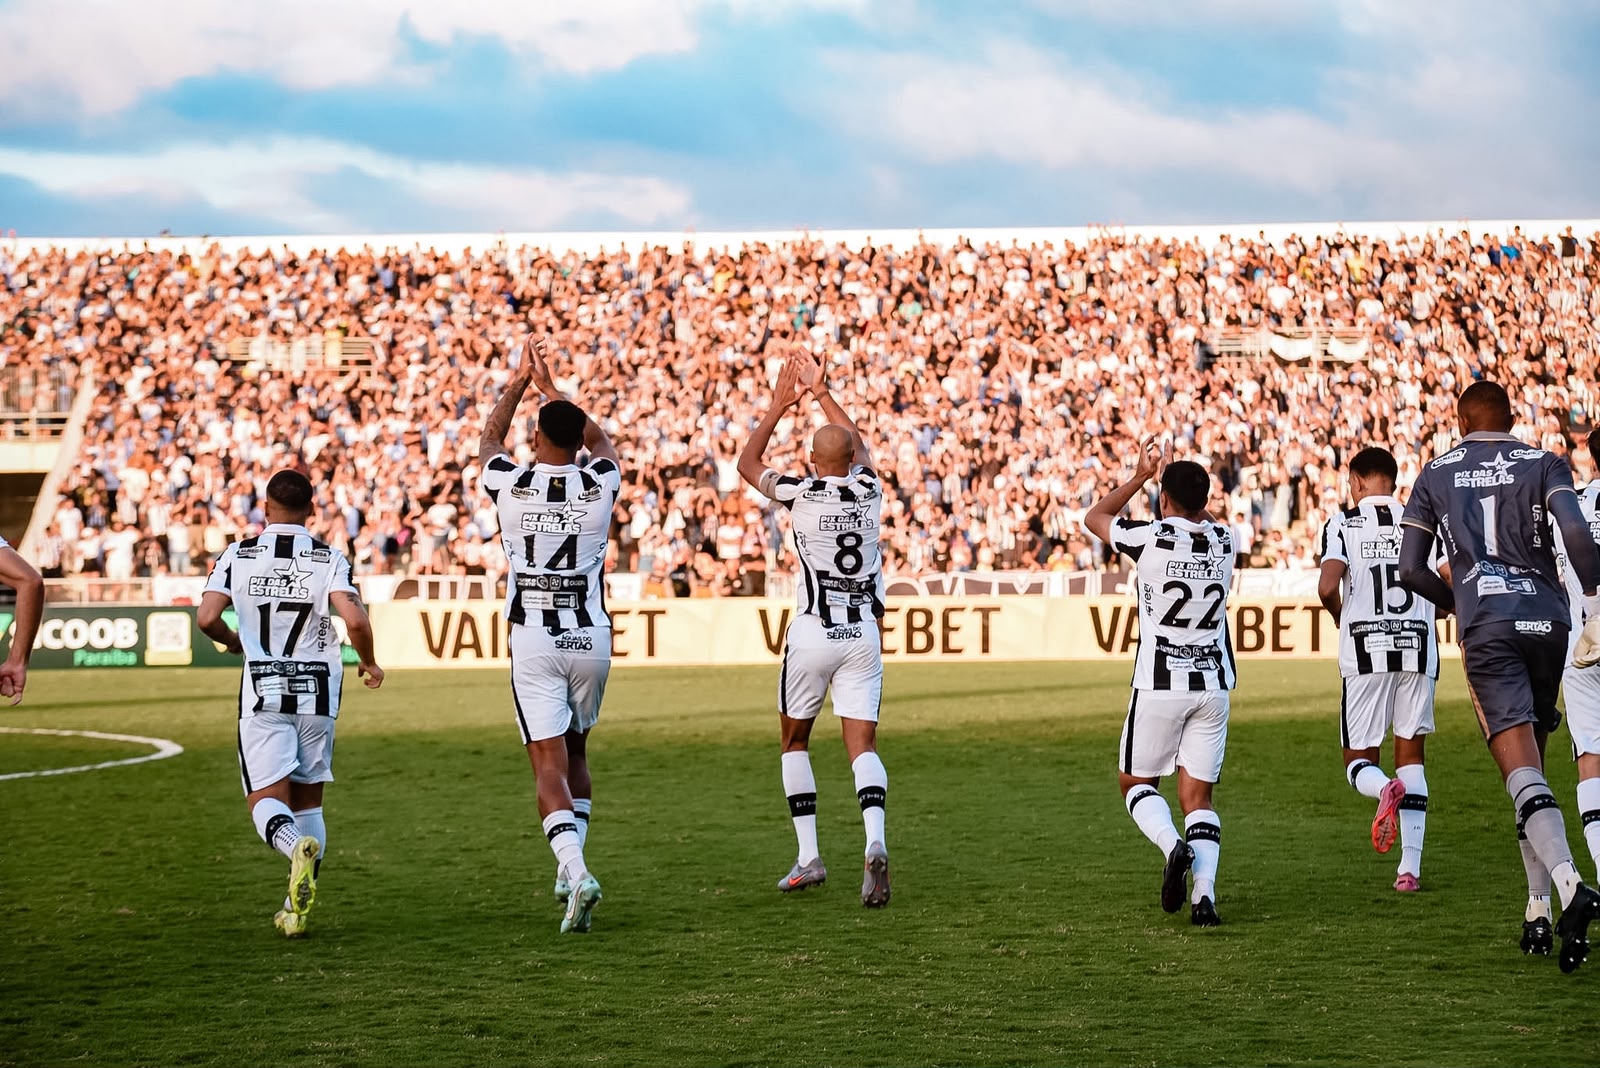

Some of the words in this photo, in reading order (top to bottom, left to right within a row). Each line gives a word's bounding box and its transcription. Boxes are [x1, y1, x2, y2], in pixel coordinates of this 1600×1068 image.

[1454, 471, 1471, 479] PIX
[1472, 469, 1493, 477] DAS
[1454, 474, 1515, 488] ESTRELAS
[523, 513, 540, 522] PIX
[540, 514, 560, 523] DAS
[821, 515, 837, 523] PIX
[837, 515, 855, 523] DAS
[522, 521, 581, 534] ESTRELAS
[820, 520, 874, 531] ESTRELAS
[1479, 494, 1499, 557] 1
[1362, 542, 1375, 550] PIX
[1376, 542, 1392, 550] DAS
[523, 534, 578, 571] 14
[834, 532, 863, 576] 8
[1362, 548, 1400, 559] ESTREL
[1169, 561, 1184, 569] PIX
[1187, 562, 1205, 570] DAS
[1167, 568, 1223, 580] ESTRELAS
[250, 577, 266, 586] PIX
[267, 578, 287, 587] DAS
[249, 585, 308, 599] ESTRELAS
[1369, 563, 1414, 616] 15
[1159, 580, 1225, 630] 22
[257, 602, 314, 658] 17
[555, 640, 593, 651] SERTÃO
